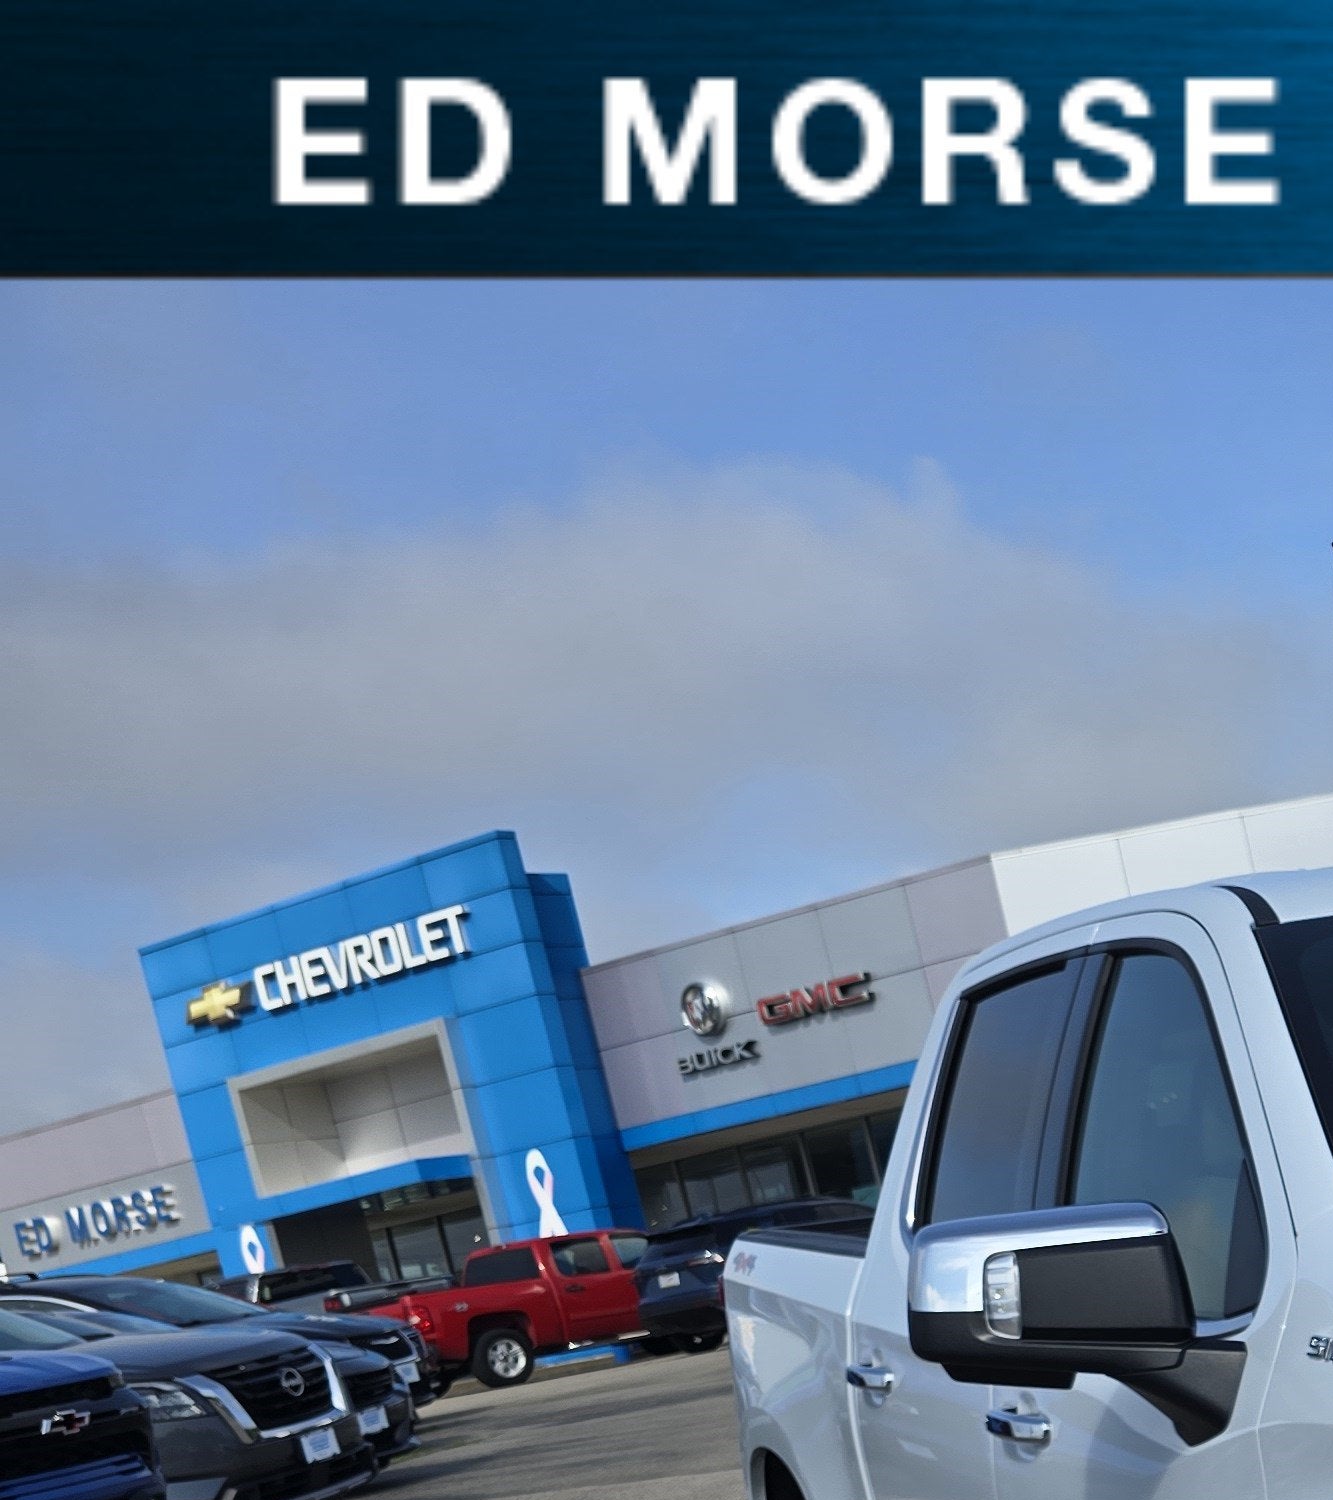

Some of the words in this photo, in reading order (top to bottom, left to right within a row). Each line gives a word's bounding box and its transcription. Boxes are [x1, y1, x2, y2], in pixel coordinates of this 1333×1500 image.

[254, 904, 466, 1012] CHEVROLET
[757, 973, 870, 1026] GMC
[678, 1040, 757, 1075] BUICK
[13, 1216, 57, 1258] ED
[65, 1184, 178, 1245] MORSE
